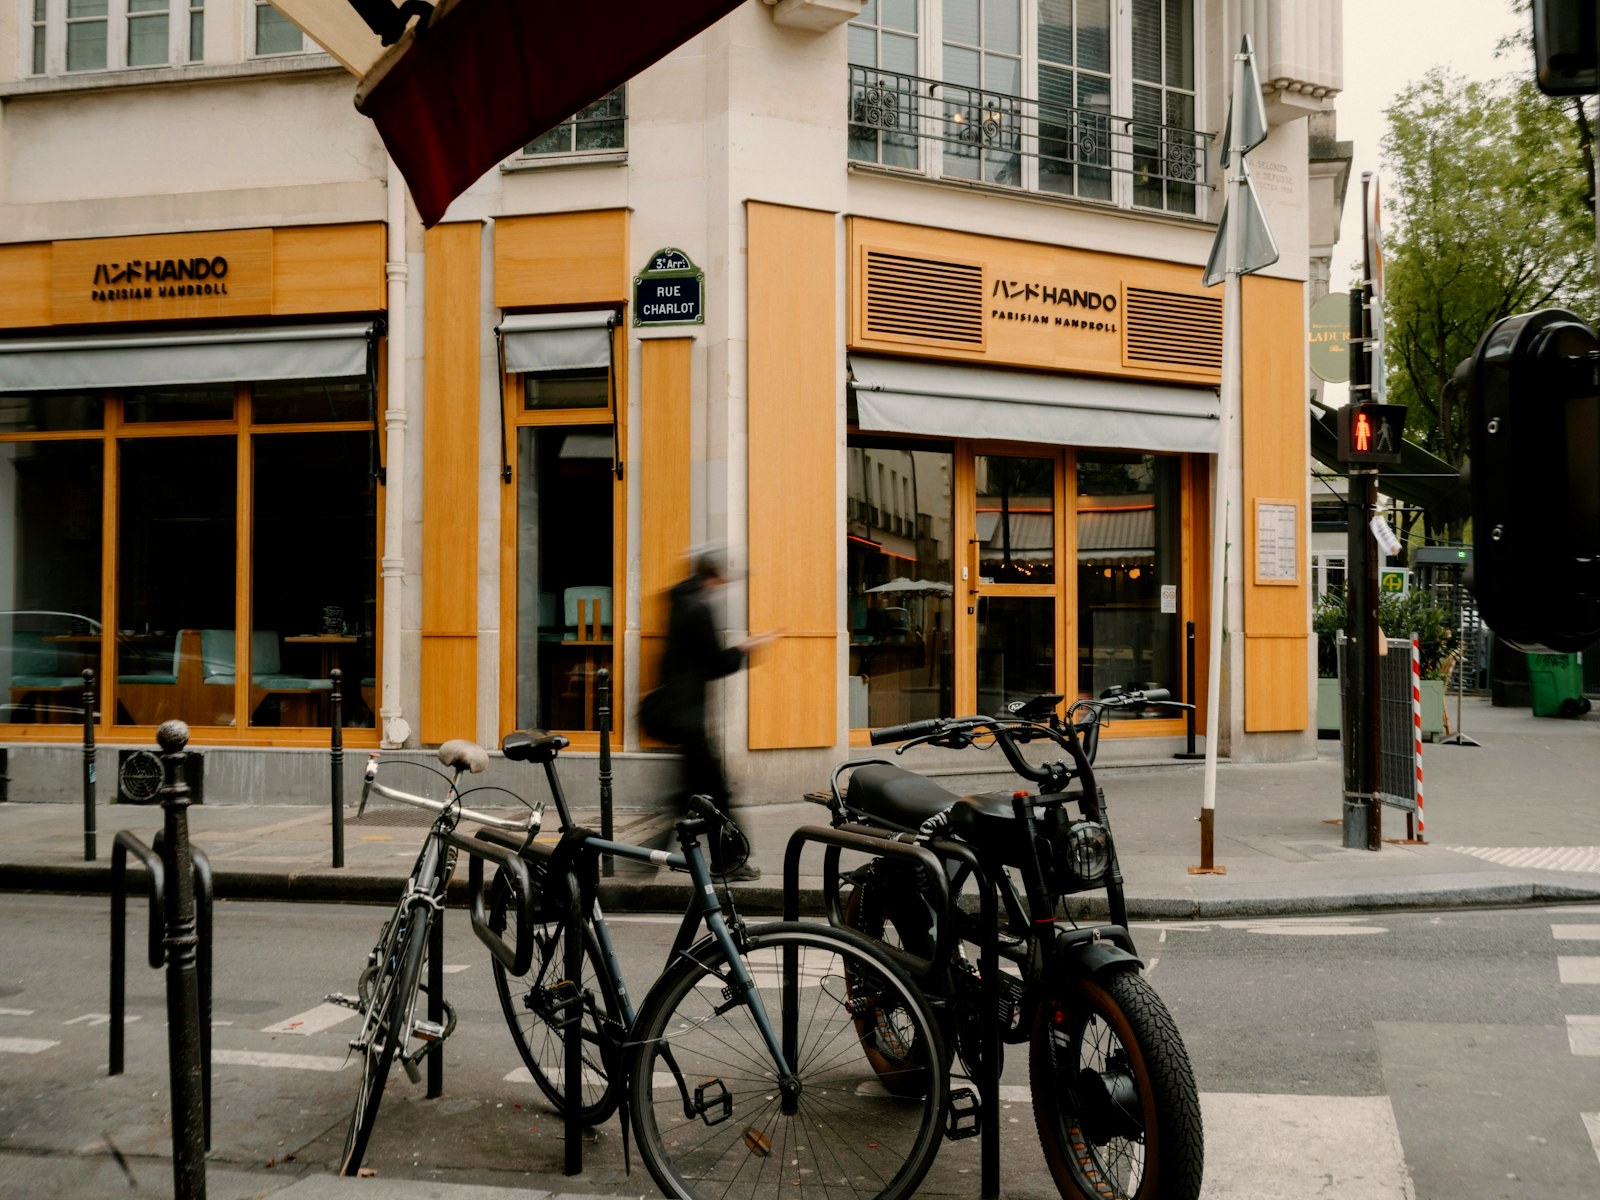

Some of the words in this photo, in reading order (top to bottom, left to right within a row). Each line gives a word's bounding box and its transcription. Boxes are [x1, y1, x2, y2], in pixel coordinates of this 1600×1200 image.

[145, 256, 228, 282] HANDO
[92, 288, 152, 302] PARISIAN
[159, 283, 228, 298] HANDROLL
[656, 286, 681, 298] RUE
[1043, 286, 1117, 312] HANDO
[643, 302, 695, 316] CHARLOT
[992, 310, 1049, 324] PARISIAN
[1055, 317, 1118, 333] HANDROLL
